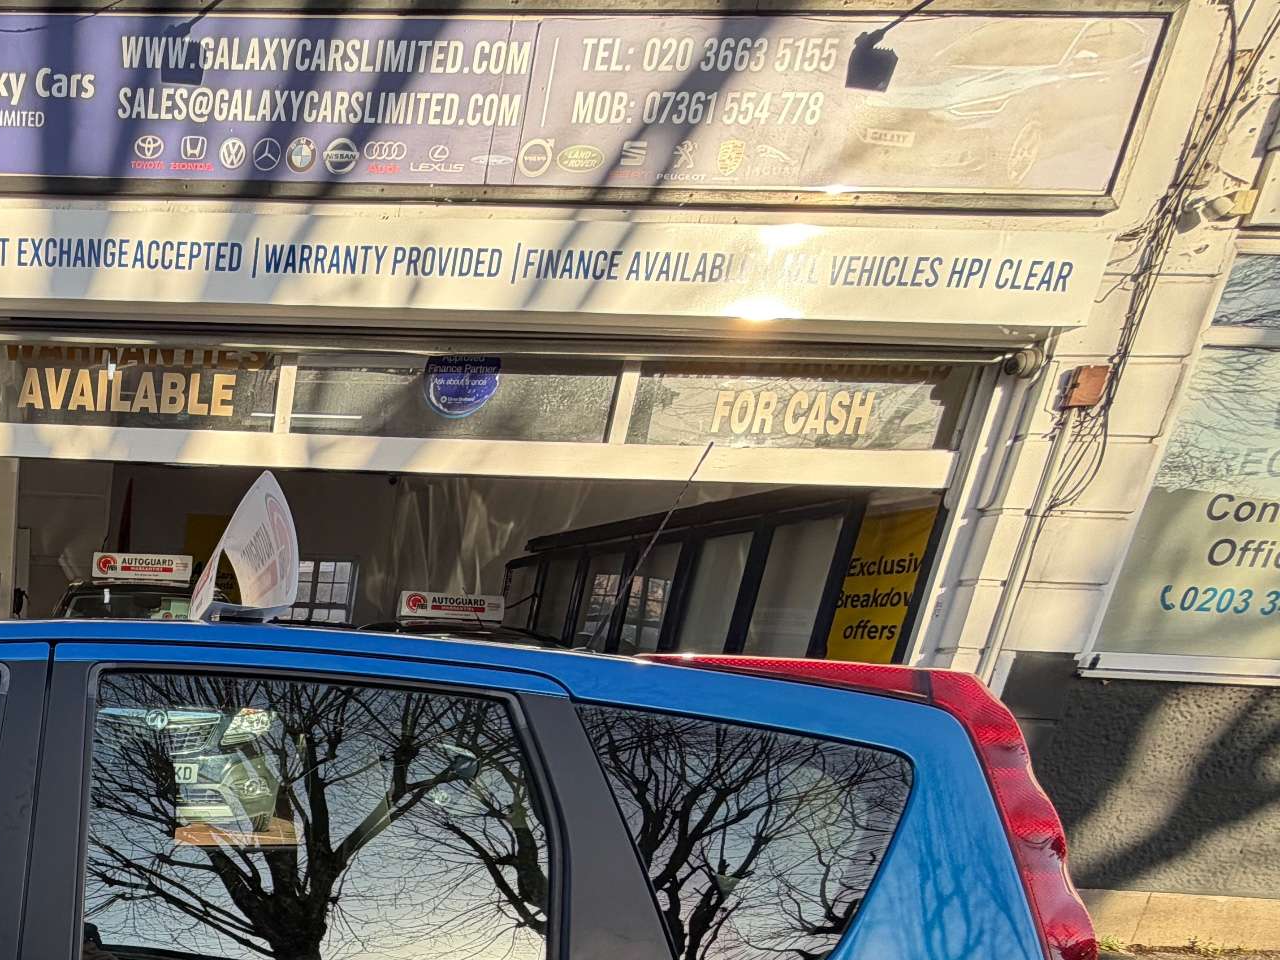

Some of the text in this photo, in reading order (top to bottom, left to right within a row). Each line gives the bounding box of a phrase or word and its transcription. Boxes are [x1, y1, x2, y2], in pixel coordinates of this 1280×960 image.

[121, 35, 531, 76] WWW.GALAXYCARSLIMITED.COM
[582, 37, 839, 73] TEL: 020 3663 5155
[34, 66, 96, 99] Cars
[117, 86, 522, 128] SALES@GALAXYCARSLIMITED.COM
[571, 91, 824, 126] MOB: 07361 554 778
[326, 152, 357, 160] NISSAN
[410, 162, 465, 172] LEXUS
[656, 172, 707, 181] PEUGEOT
[17, 238, 129, 270] EXCHANGE
[133, 240, 243, 273] ACCEPTED
[264, 244, 388, 277] WARRANTY
[391, 246, 503, 279] PROVIDED
[522, 249, 624, 281] FINANCE
[831, 256, 940, 289] VEHICLES
[947, 257, 990, 290] HPI
[993, 259, 1074, 293] CLEAR
[429, 363, 497, 373] Finance Partner
[17, 367, 237, 417] AVAILABLE
[710, 390, 875, 435] FOR CASH
[121, 557, 174, 567] AUTOGUARD
[1207, 538, 1280, 569] Offi
[431, 596, 486, 607] AUTOGUARD
[1179, 586, 1254, 614] 0203
[843, 619, 898, 640] offers
